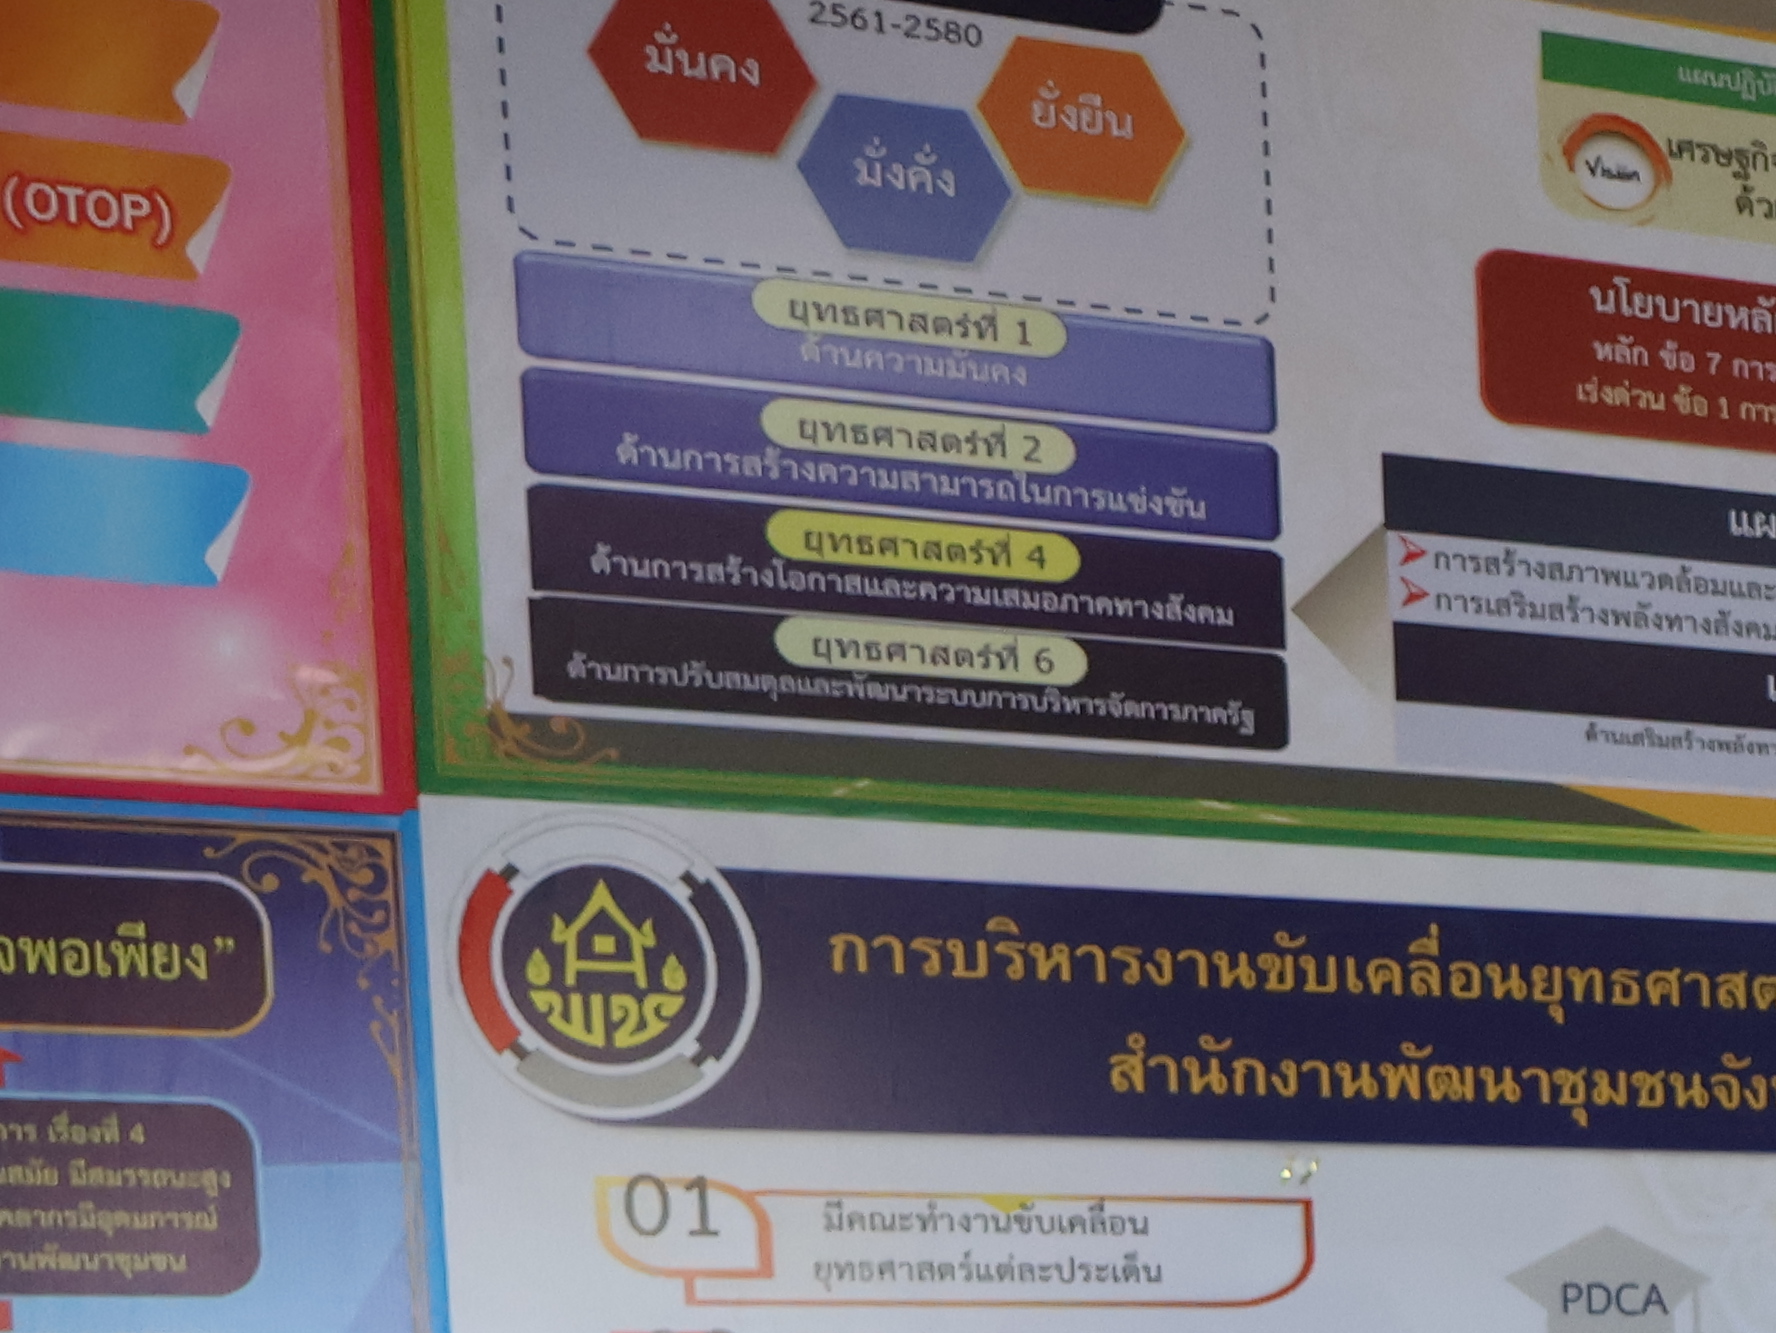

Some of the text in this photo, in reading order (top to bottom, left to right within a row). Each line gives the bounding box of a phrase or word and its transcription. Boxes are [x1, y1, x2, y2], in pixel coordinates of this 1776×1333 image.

[810, 0, 984, 48] 2561-2580
[643, 21, 761, 87] มั่นคง
[1031, 80, 1134, 140] ยั่งยืน
[853, 136, 957, 197] มั่งคั่ง
[3, 175, 172, 246] (OTOP)
[1016, 320, 1033, 348] 1
[1707, 351, 1721, 377] 7
[1717, 395, 1729, 420] 1
[1022, 435, 1042, 464] 2
[1025, 542, 1047, 569] 4
[1033, 647, 1055, 676] 6
[623, 1174, 720, 1237] 01
[1560, 1281, 1670, 1317] PDCA
